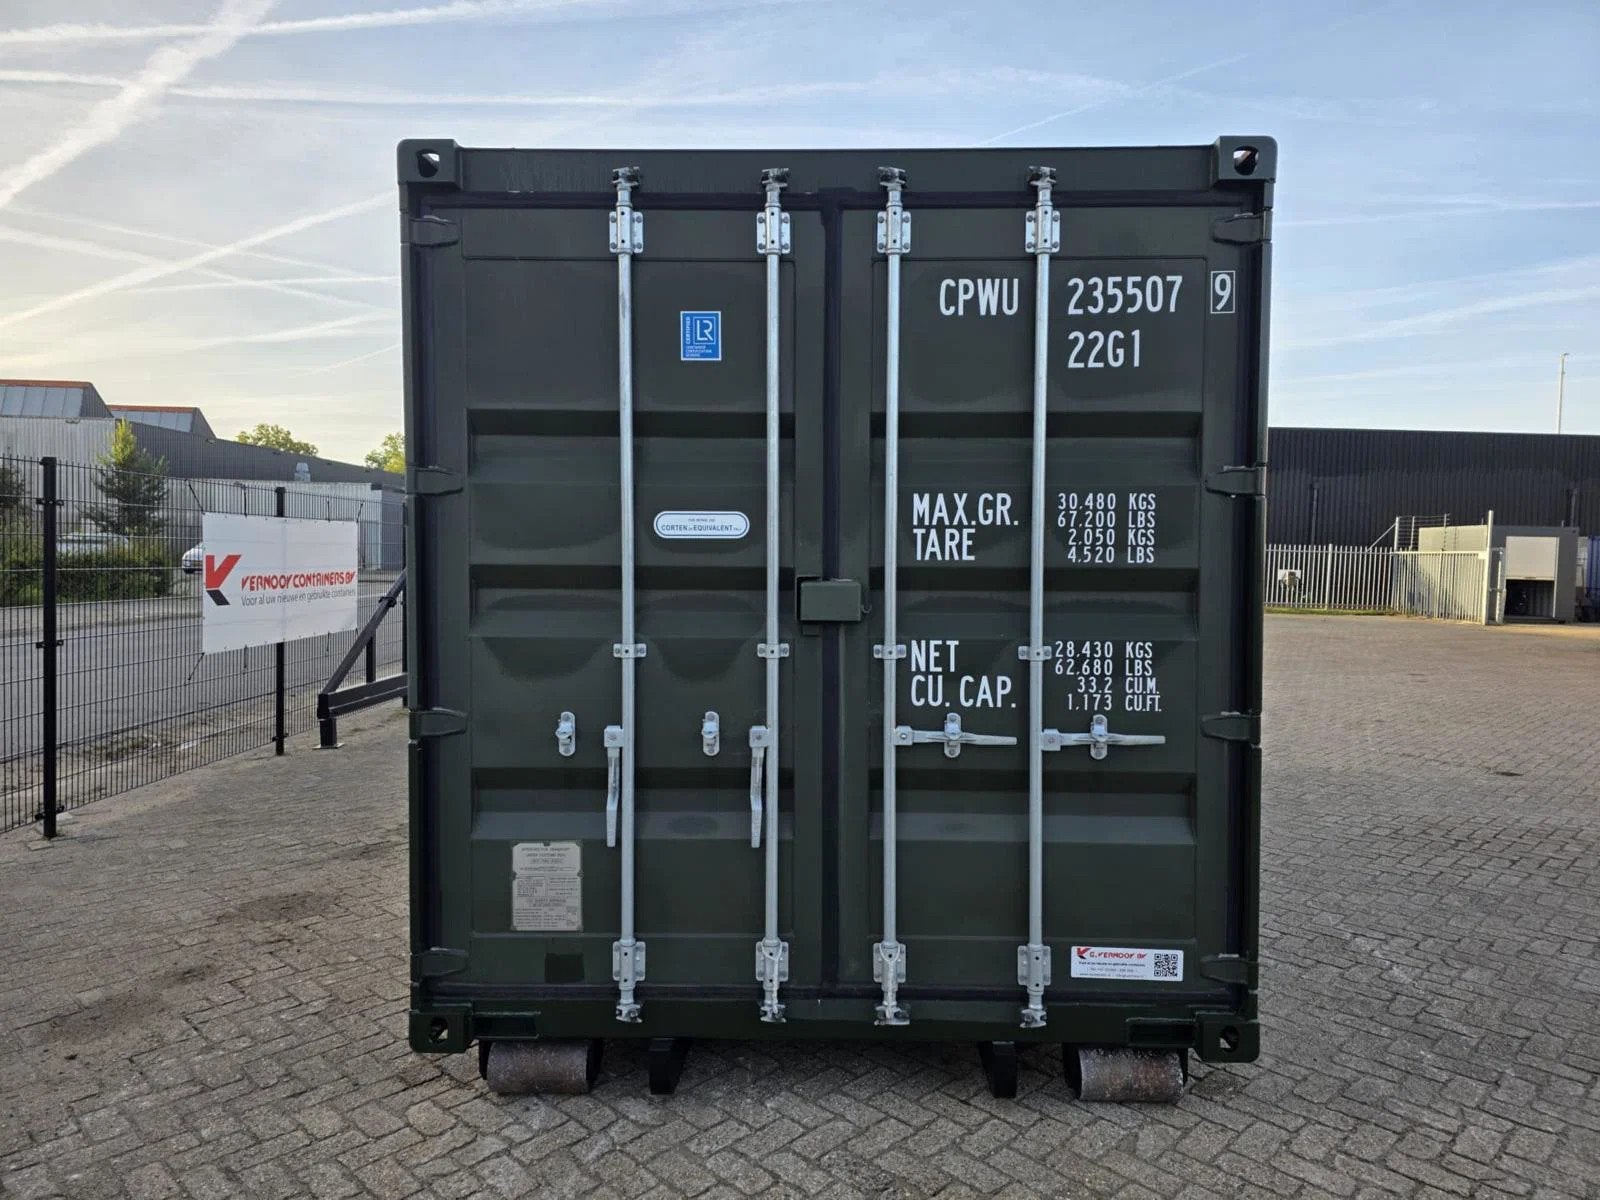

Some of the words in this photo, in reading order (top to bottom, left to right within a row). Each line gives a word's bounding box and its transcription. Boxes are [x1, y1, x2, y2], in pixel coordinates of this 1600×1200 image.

[939, 277, 1019, 316] CPWU
[1067, 275, 1183, 315] 235507
[1214, 274, 1232, 310] 9
[696, 319, 714, 341] LR
[1067, 329, 1140, 369] 22G1
[912, 492, 1019, 526] MAX.GR.
[1128, 493, 1156, 510] KGS
[1128, 511, 1156, 528] LBS
[912, 528, 976, 561] TARE
[1127, 528, 1155, 546] KGS
[1127, 546, 1155, 563] LBS
[293, 571, 345, 588] CONTAINERS
[241, 594, 258, 606] Voor
[259, 592, 265, 605] al
[266, 595, 276, 604] uw
[911, 640, 960, 672] NET
[1125, 641, 1153, 658] KGS
[1125, 659, 1153, 676] LBS
[910, 674, 951, 707] CU.
[959, 675, 1017, 708] CAP.
[1077, 676, 1113, 693] 33.2
[1125, 676, 1160, 694] CU.M.
[1125, 694, 1162, 711] CU.FT.
